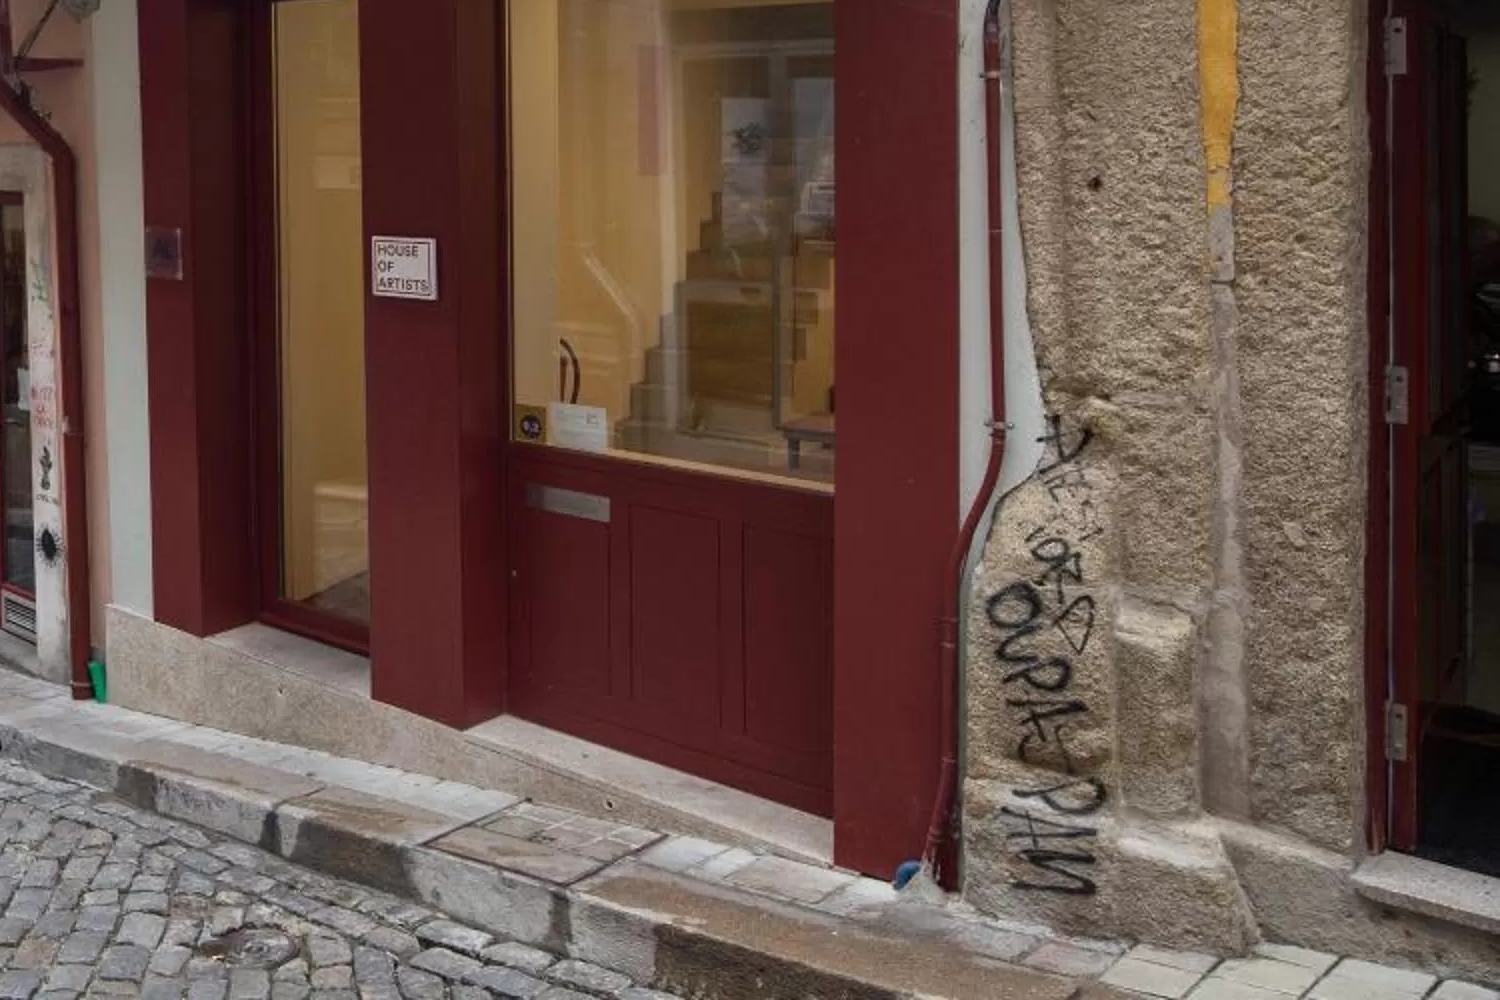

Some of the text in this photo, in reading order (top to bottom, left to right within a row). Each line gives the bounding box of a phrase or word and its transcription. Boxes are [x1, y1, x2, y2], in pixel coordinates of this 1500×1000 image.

[377, 244, 419, 257] HOUSE
[377, 260, 396, 273] OF
[379, 277, 429, 292] ARTISTS
